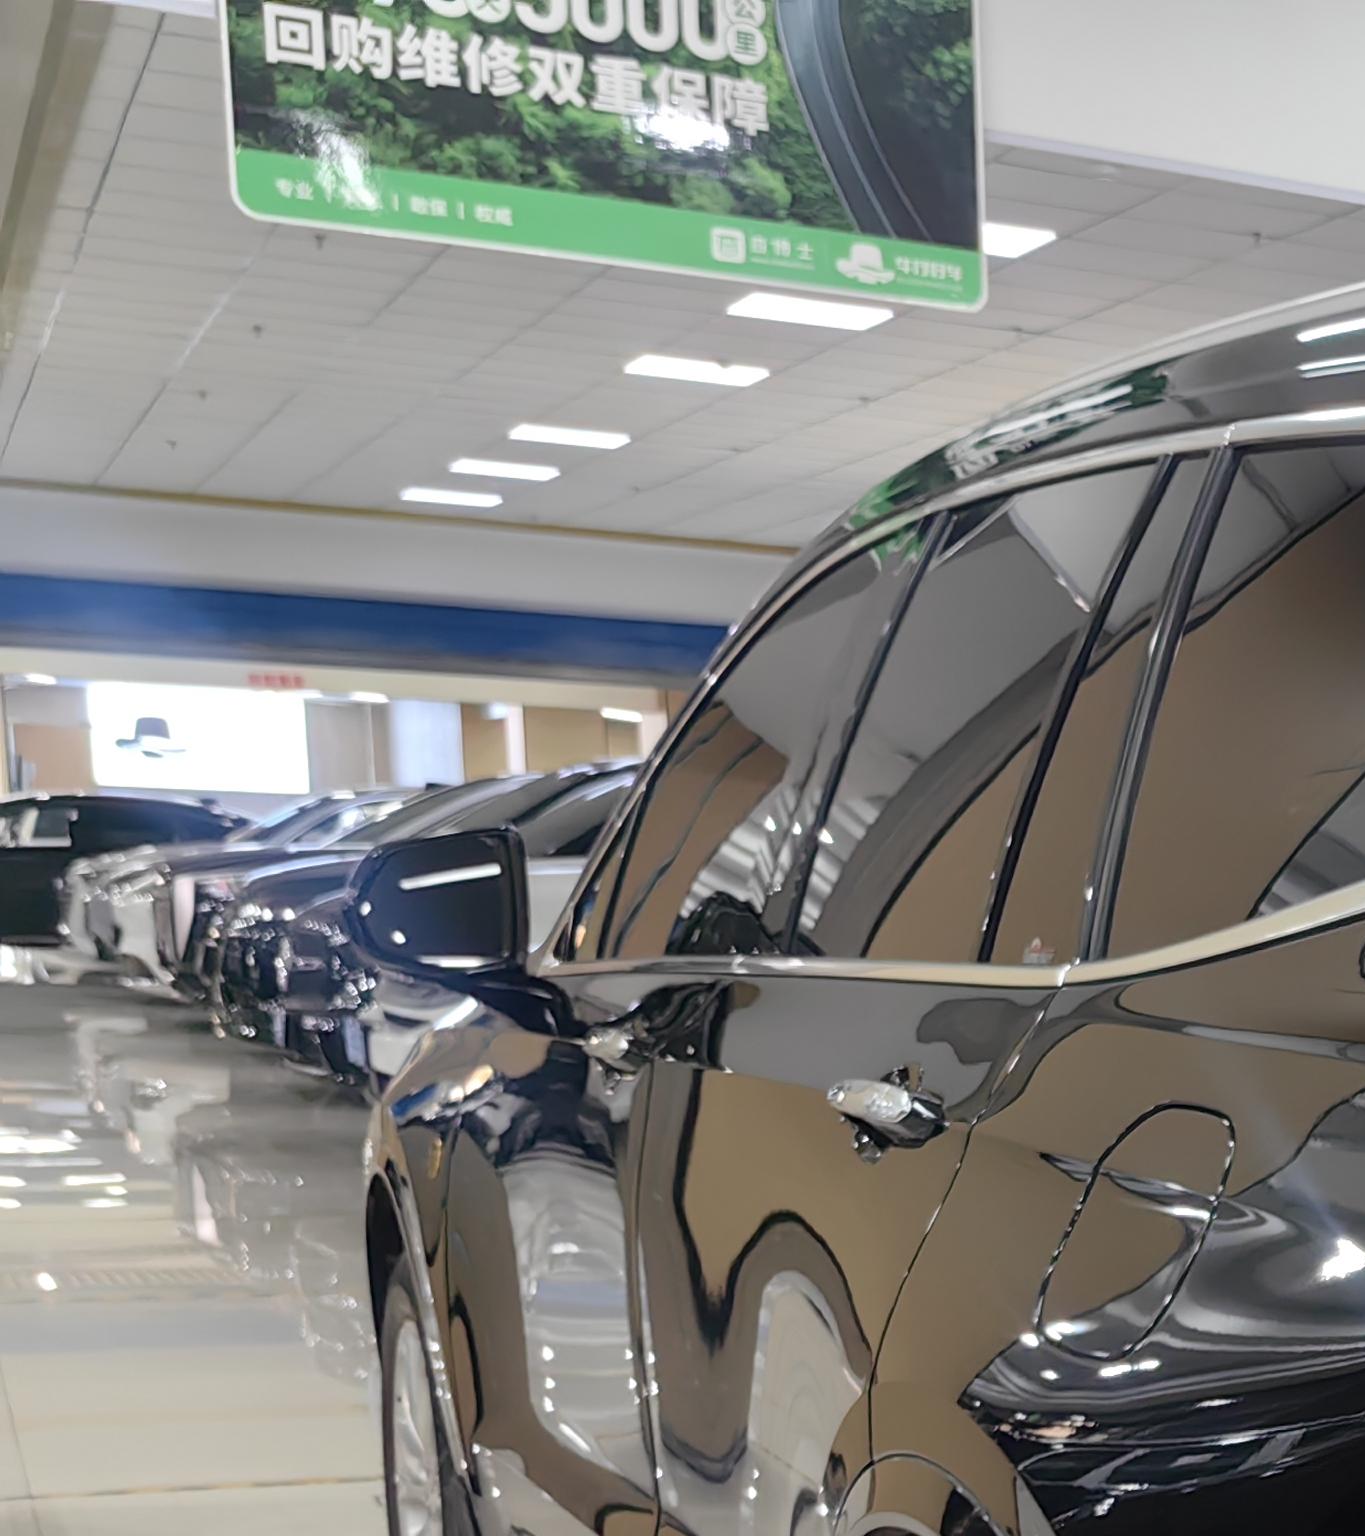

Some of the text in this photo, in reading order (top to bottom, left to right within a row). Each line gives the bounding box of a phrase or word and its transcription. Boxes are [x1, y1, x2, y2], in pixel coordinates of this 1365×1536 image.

[262, 2, 769, 137] 回购维修双重保障
